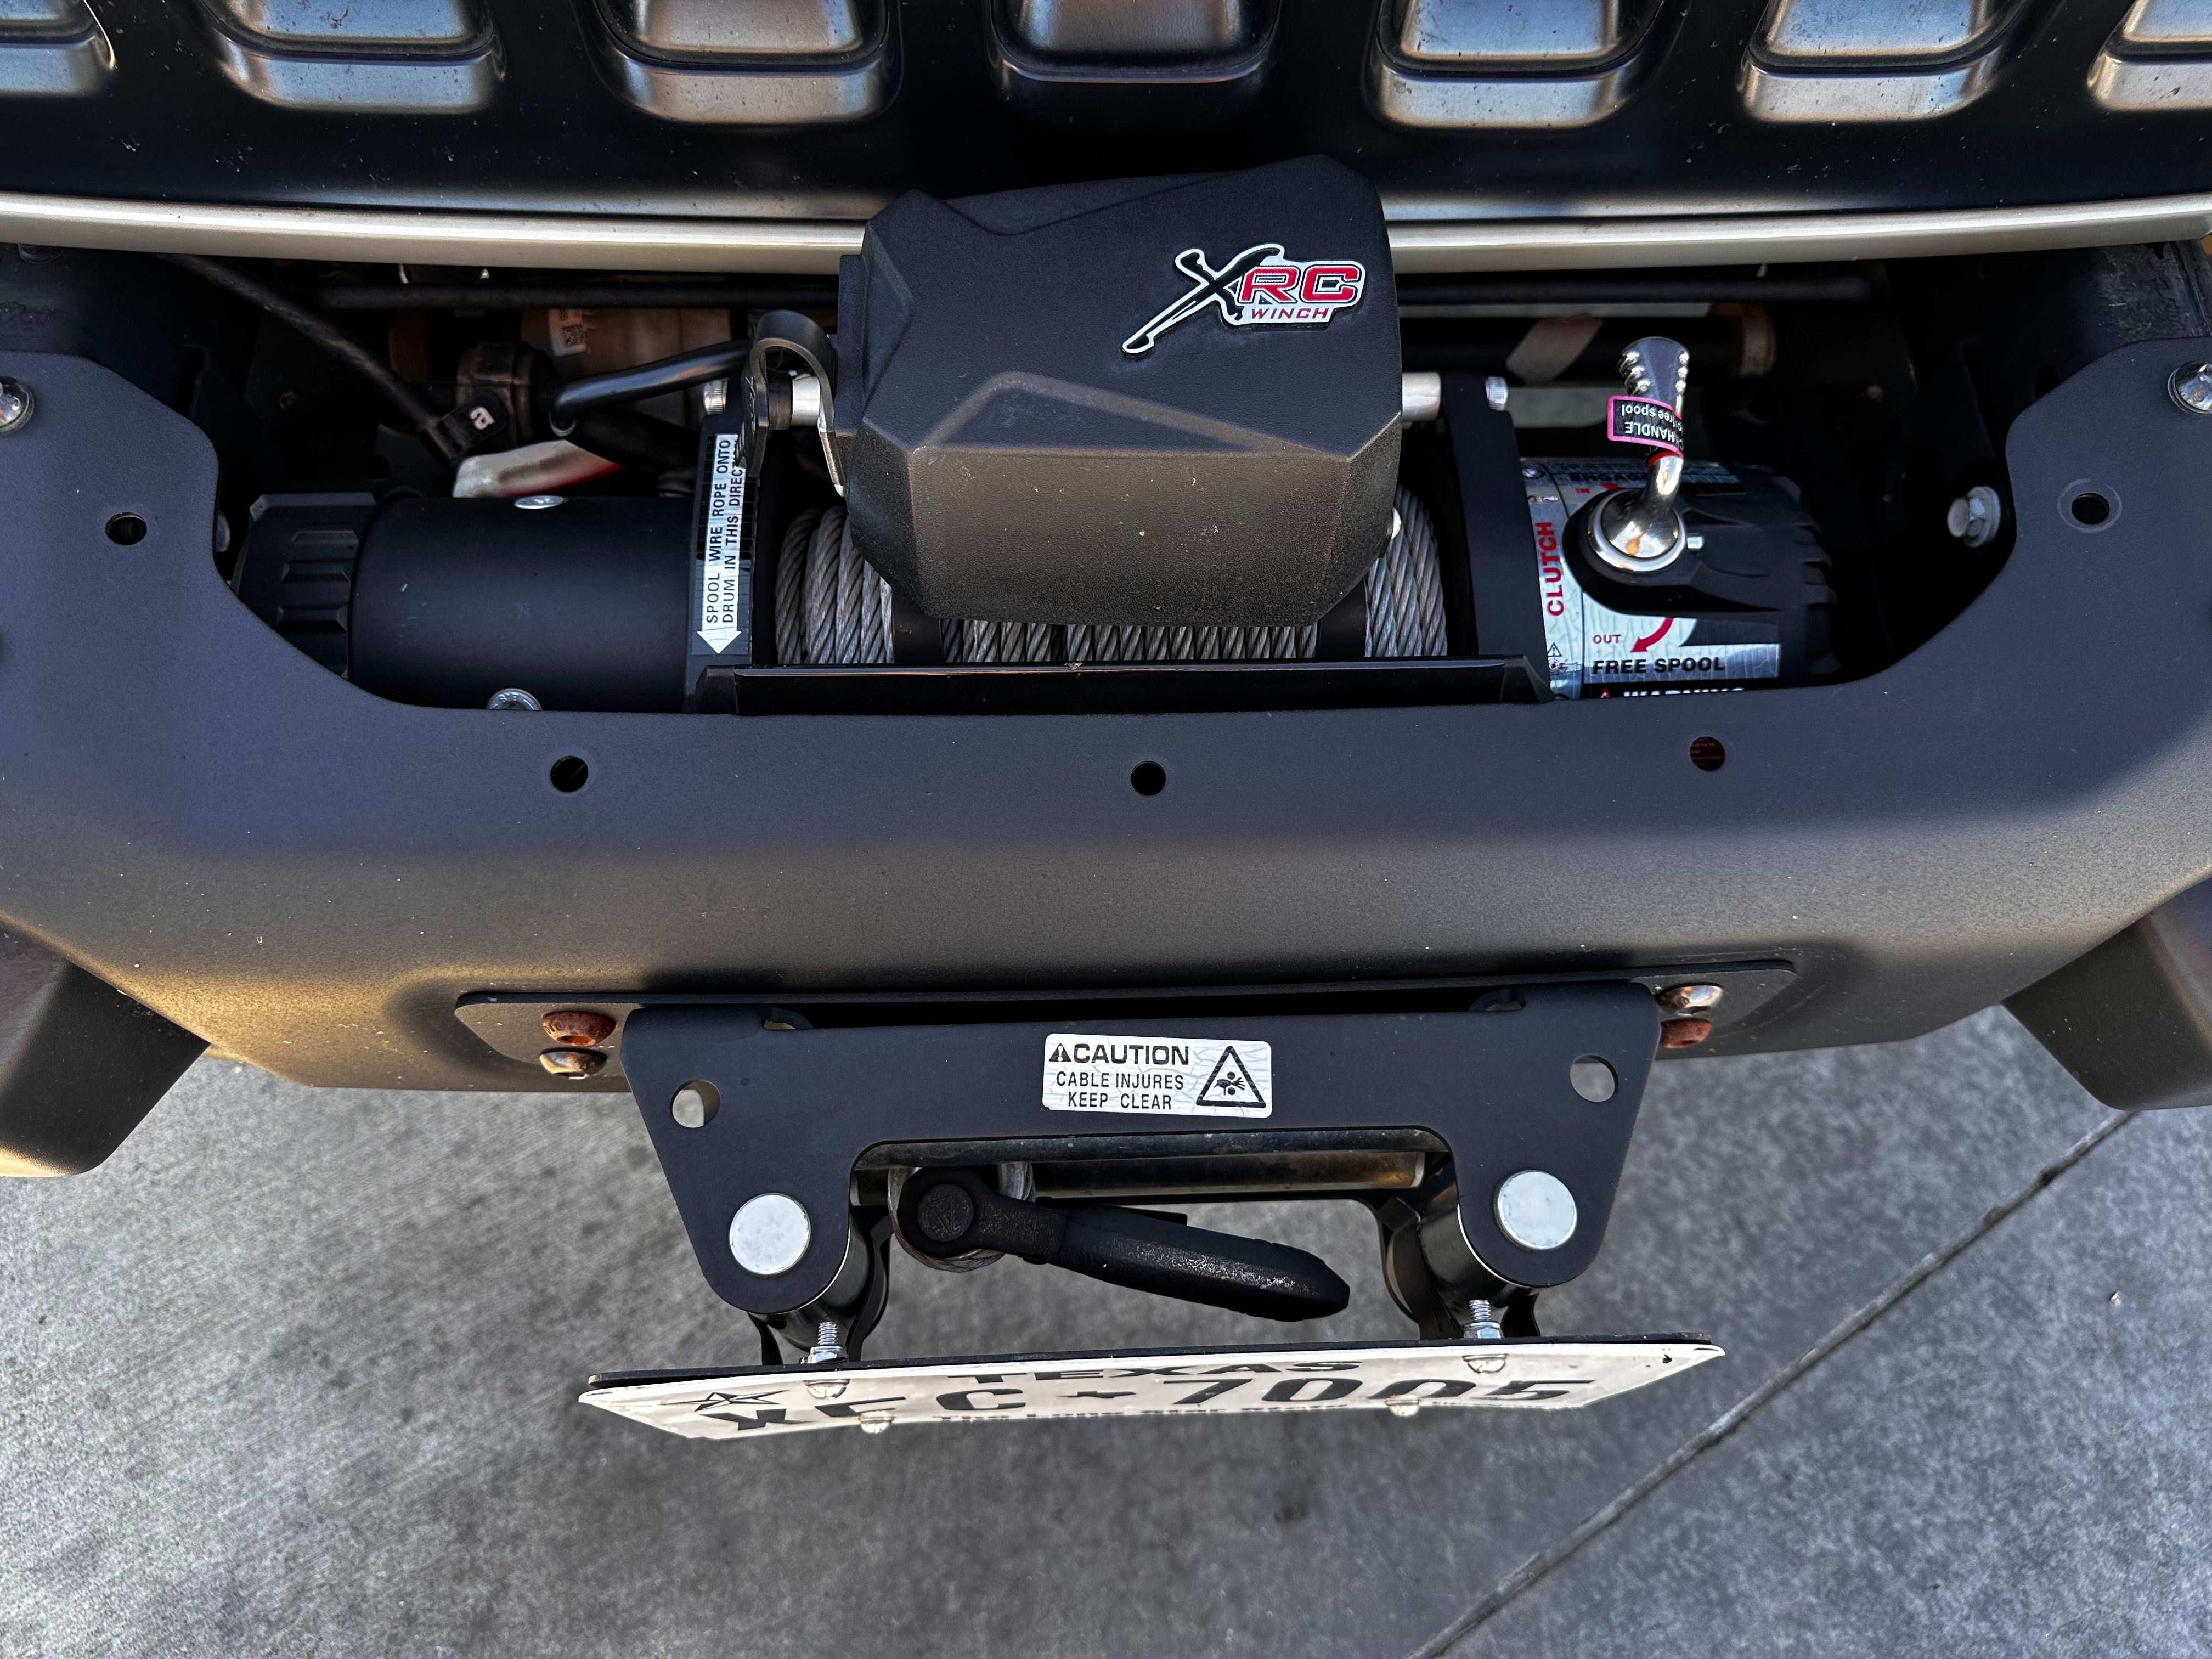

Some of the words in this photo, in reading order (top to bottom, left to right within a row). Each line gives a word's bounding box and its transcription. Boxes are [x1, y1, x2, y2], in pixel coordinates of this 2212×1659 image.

[1251, 307, 1329, 320] WINCH
[1621, 404, 1657, 417] spool
[1624, 421, 1675, 443] HANDLE
[716, 439, 731, 473] ONTO
[1570, 473, 1646, 482] ENGAG
[712, 483, 727, 517] ROPE
[725, 516, 739, 546] THIS
[708, 526, 723, 562] WIRE
[724, 555, 736, 570] IN
[1535, 522, 1565, 617] CLUTCH
[706, 573, 720, 623] SPOOL
[722, 579, 736, 623] DRUM
[1592, 633, 1622, 645] OUT
[1592, 659, 1647, 674] FREE
[1653, 657, 1725, 673] SPOOL
[1073, 1043, 1189, 1065] CAUTION
[1056, 1070, 1110, 1088] CABLE
[1115, 1073, 1184, 1090] INJURES
[1068, 1091, 1108, 1108] KEEP
[1120, 1093, 1172, 1110] CLEAR
[948, 1361, 1362, 1384] TEXAS
